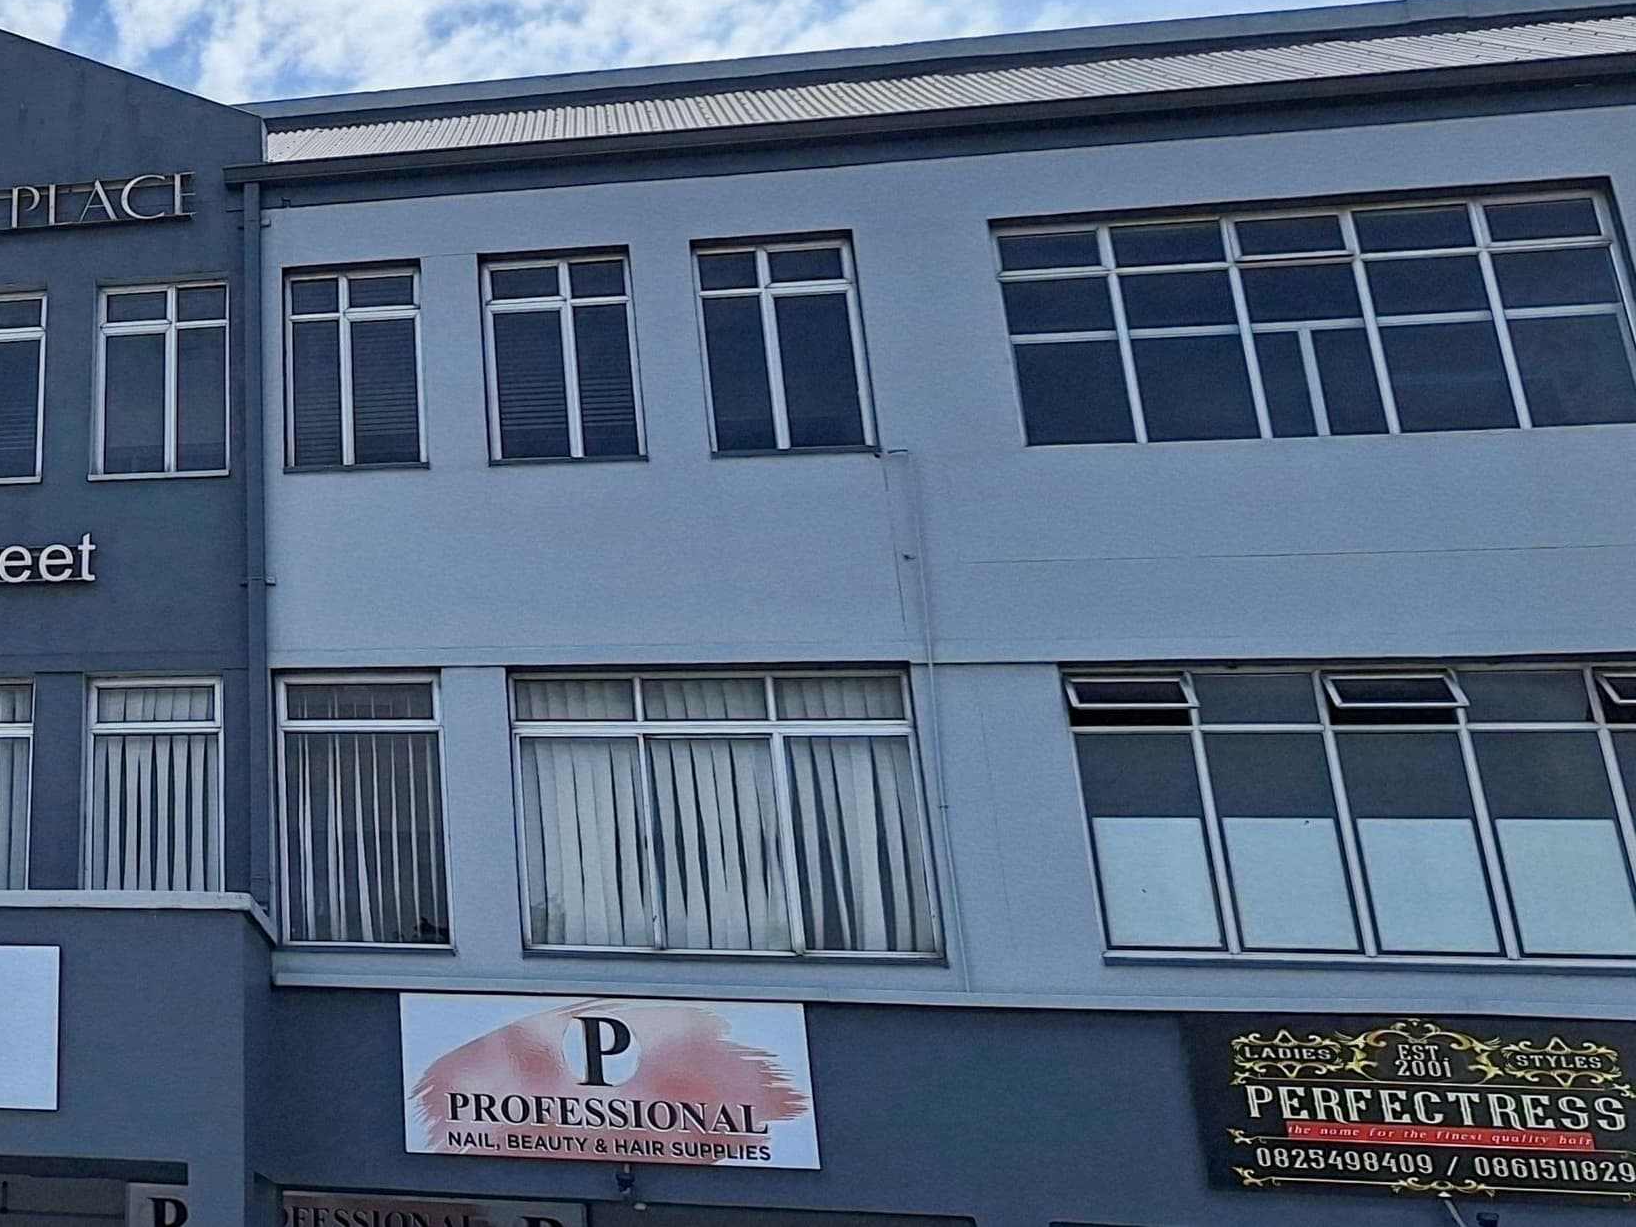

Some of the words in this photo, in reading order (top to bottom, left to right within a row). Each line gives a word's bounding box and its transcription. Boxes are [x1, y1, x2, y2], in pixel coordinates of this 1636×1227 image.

[11, 171, 197, 229] PLACE
[572, 1016, 632, 1087] P
[1244, 1046, 1332, 1060] LADIES
[1515, 1054, 1603, 1069] STYLES
[1394, 1060, 1452, 1078] 2001
[445, 1092, 770, 1136] PROFESSIONAL
[1245, 1085, 1627, 1132] PERFECTRESS
[448, 1131, 501, 1151] NAIL,
[507, 1134, 589, 1153] BEAUTY
[594, 1137, 608, 1154] &
[615, 1137, 665, 1157] HAIR
[671, 1141, 772, 1162] SUPPLIES
[1288, 1124, 1311, 1135] the
[1368, 1127, 1395, 1138] for
[1404, 1128, 1427, 1139] the
[1491, 1133, 1549, 1145] quality
[1559, 1135, 1594, 1146] hair
[1255, 1147, 1433, 1175] 0825498409
[1474, 1156, 1636, 1183] 0861511829
